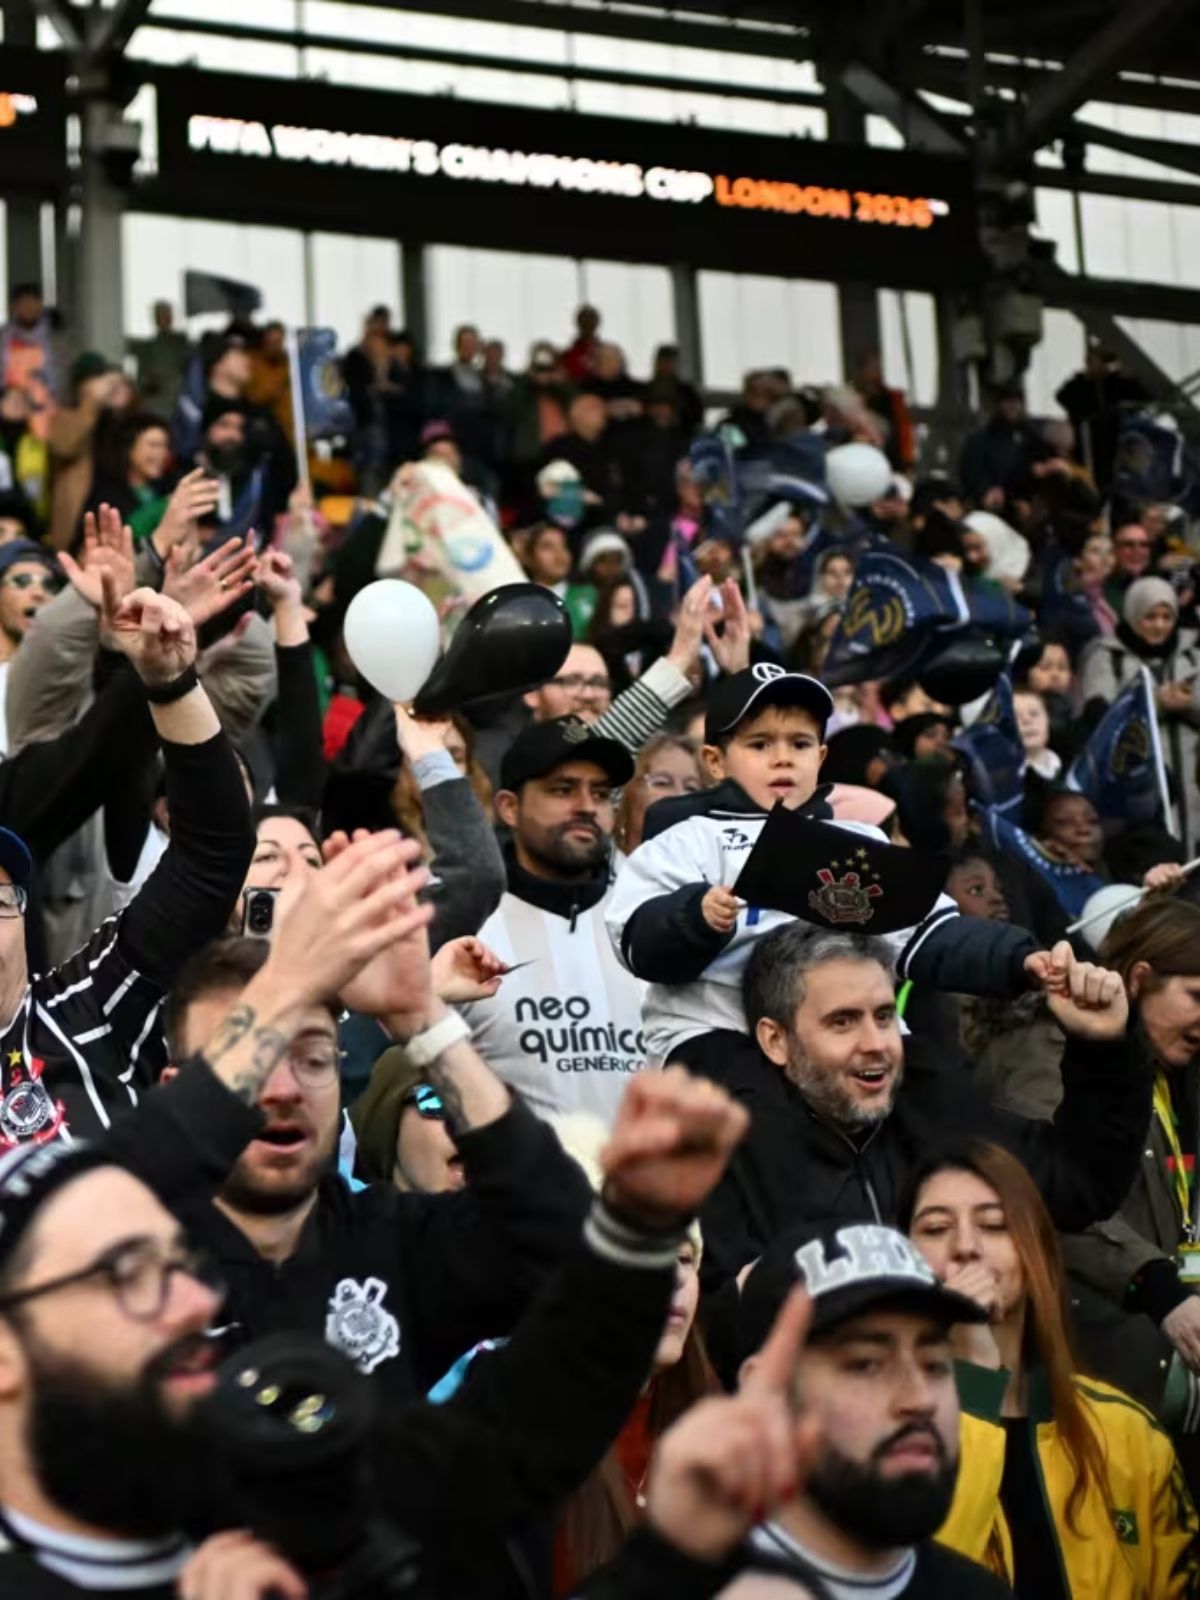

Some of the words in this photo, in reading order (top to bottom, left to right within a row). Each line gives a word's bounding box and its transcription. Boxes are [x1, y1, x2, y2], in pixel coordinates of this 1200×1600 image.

[188, 114, 272, 158] FIFA
[271, 124, 440, 176] WOMEN'S
[439, 143, 644, 198] CHAMPIONS
[644, 166, 714, 203] CUP
[715, 174, 851, 220] LONDON
[515, 996, 591, 1023] neo
